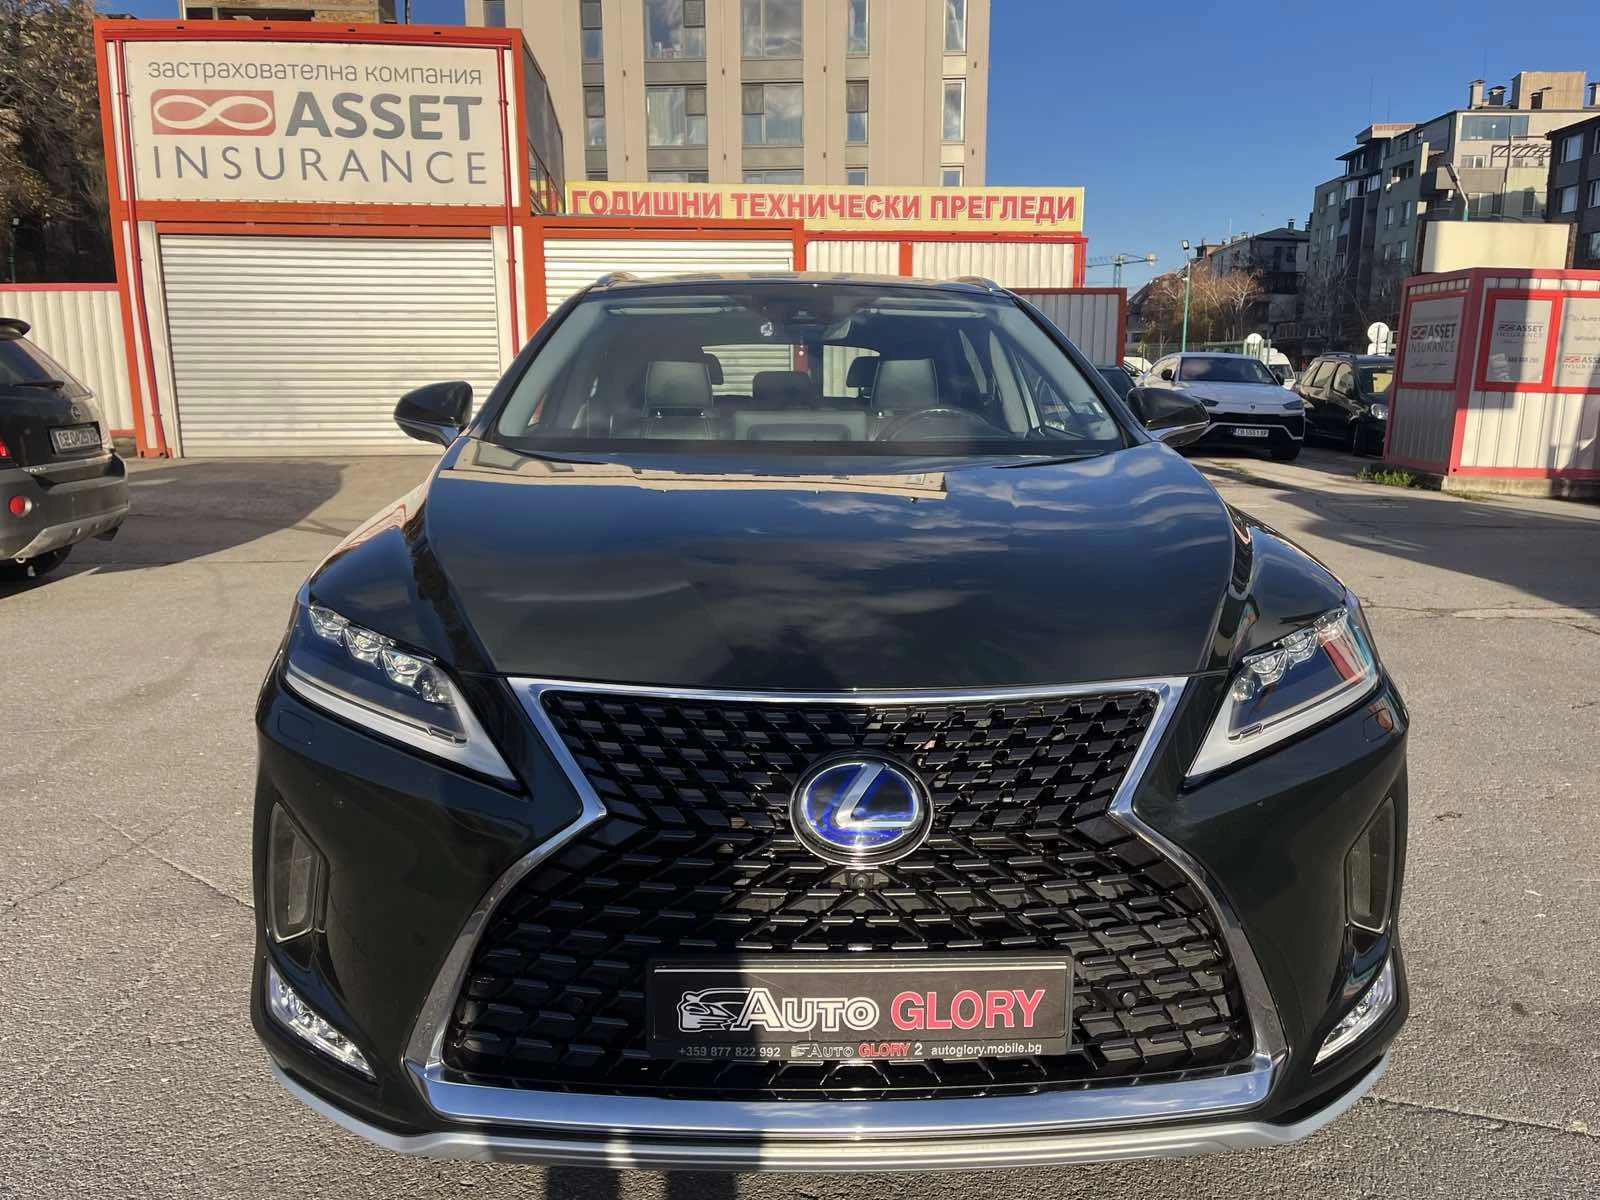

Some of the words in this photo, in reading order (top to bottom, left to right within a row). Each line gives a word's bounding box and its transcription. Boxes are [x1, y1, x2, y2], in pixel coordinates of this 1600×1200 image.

[148, 61, 357, 84] застрахователна
[365, 63, 481, 85] компания
[285, 91, 482, 141] ASSET
[153, 145, 487, 185] INSURANCE
[570, 189, 722, 219] ГОДИШНИ
[730, 191, 921, 221] ТЕХНИЧЕСКИ
[929, 195, 1076, 225] ПРЕГЛЕДИ
[1428, 323, 1456, 338] ASSET
[1408, 340, 1456, 353] INSURANCE
[891, 989, 1046, 1030] GLORY
[678, 1046, 707, 1057] +359
[710, 1046, 733, 1057] 877
[735, 1046, 756, 1057] 822
[759, 1046, 781, 1057] 992
[858, 1043, 912, 1057] GLORY
[914, 1043, 923, 1056] 2
[931, 1042, 1042, 1057] autoglory.mobile.bg
